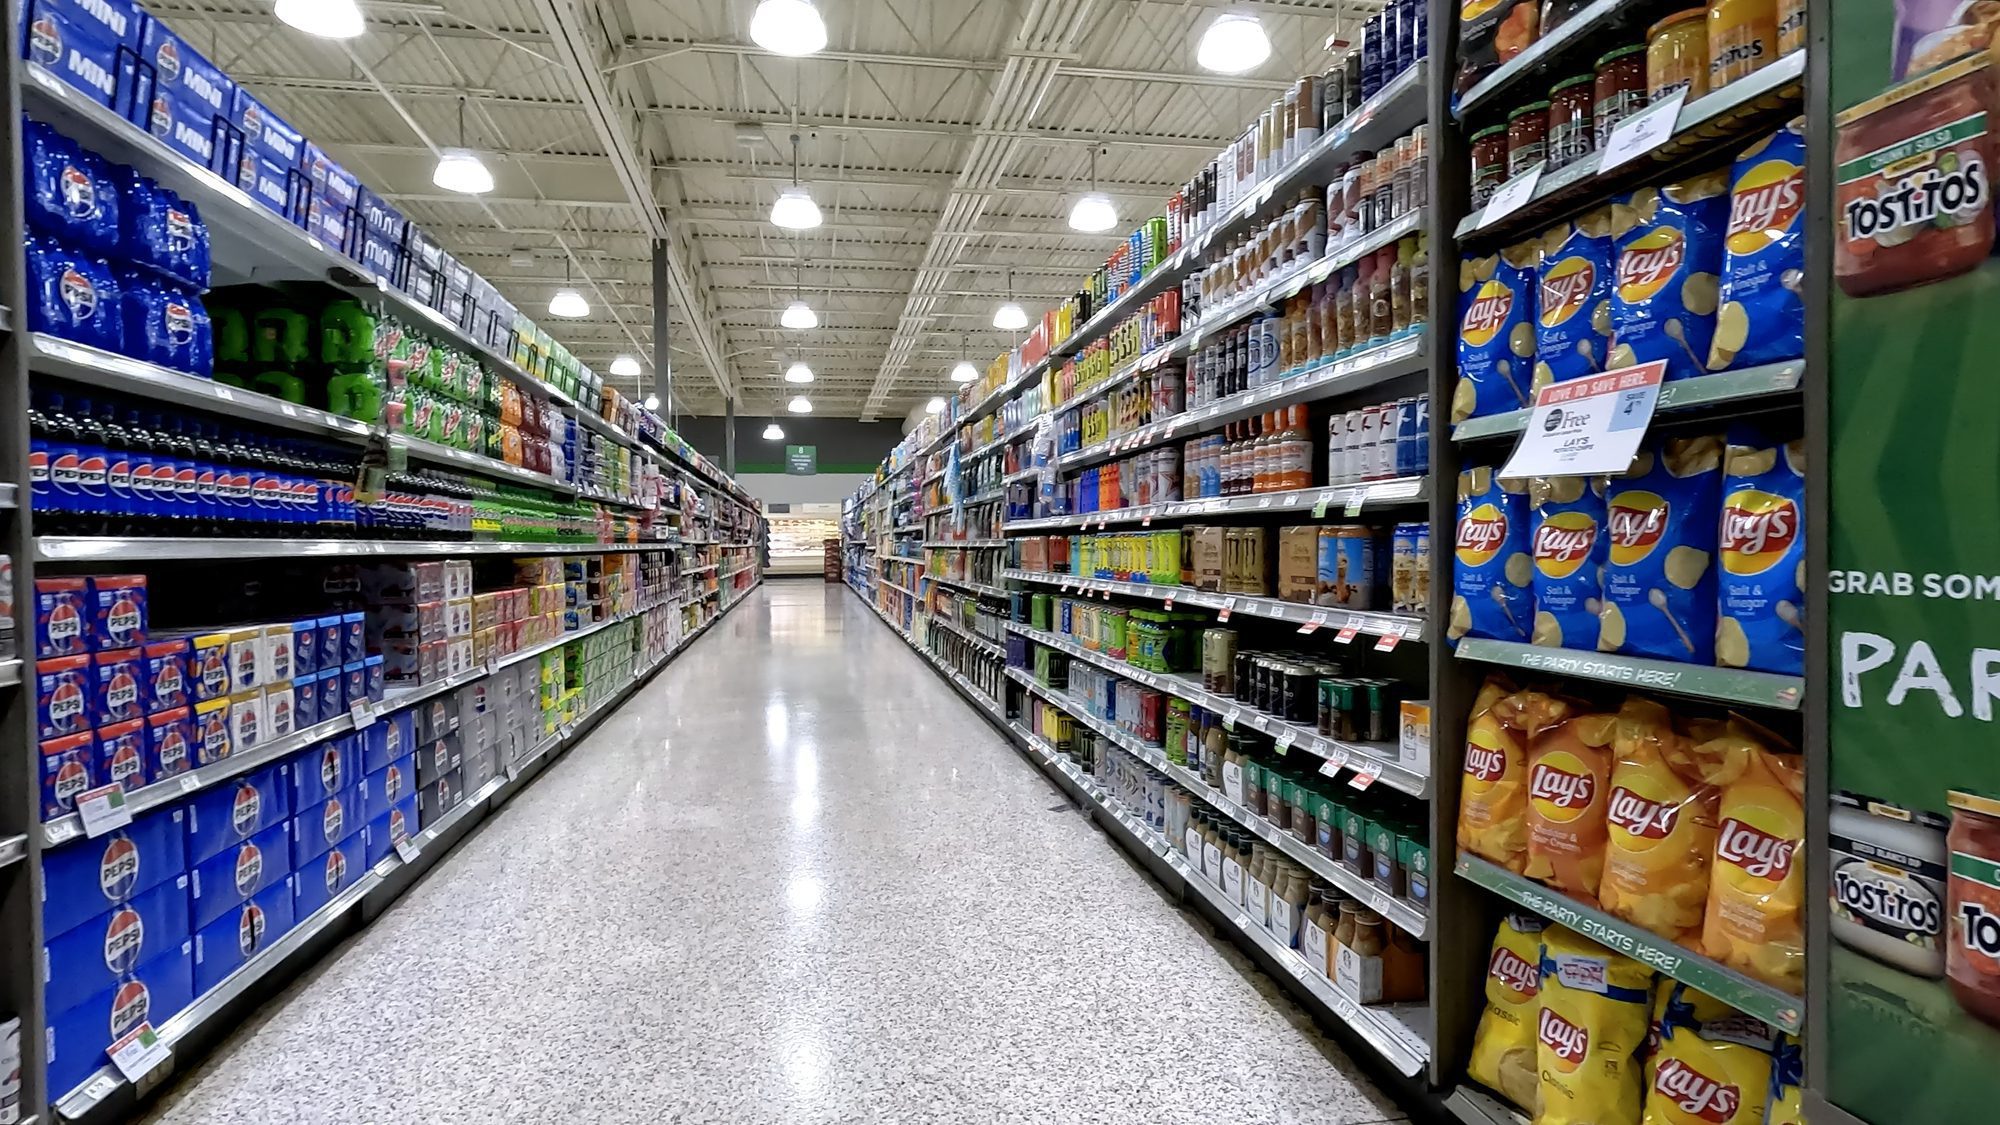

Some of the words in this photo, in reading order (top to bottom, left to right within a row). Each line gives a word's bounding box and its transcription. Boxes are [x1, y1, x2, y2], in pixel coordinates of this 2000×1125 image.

[1915, 129, 1953, 153] SALSA
[1728, 177, 1804, 233] Lay's
[1847, 163, 1981, 239] TOSTITOS
[1575, 384, 1588, 397] TO
[1591, 378, 1616, 394] SAVE
[1561, 411, 1591, 429] Free
[1457, 519, 1504, 552] Lay's
[1535, 527, 1593, 562] Lay's
[1720, 507, 1791, 555] Lay's
[1828, 570, 1915, 596] GRAB
[51, 623, 78, 634] PEPSI
[1520, 653, 1541, 666] THE
[1543, 657, 1581, 672] PARTY
[1583, 661, 1633, 679] STARTS
[1636, 669, 1681, 688] HERE!
[52, 696, 80, 712] PEPSI
[109, 688, 135, 702] PEPSI
[114, 760, 138, 775] PEPSI
[1464, 743, 1503, 781] Lay's
[1532, 766, 1592, 807] Lay's
[1717, 819, 1792, 877] Lay's
[104, 858, 138, 882] PEPSI
[1835, 871, 1941, 934] TOSTITOS
[108, 929, 143, 955] PEPSI
[1543, 901, 1582, 926] PARTY
[1582, 919, 1634, 951] STARTS
[1635, 943, 1683, 975] HERE!
[114, 1001, 148, 1029] PEPSI
[1539, 1008, 1587, 1058] Lay's
[1656, 1060, 1736, 1114] Lay's
